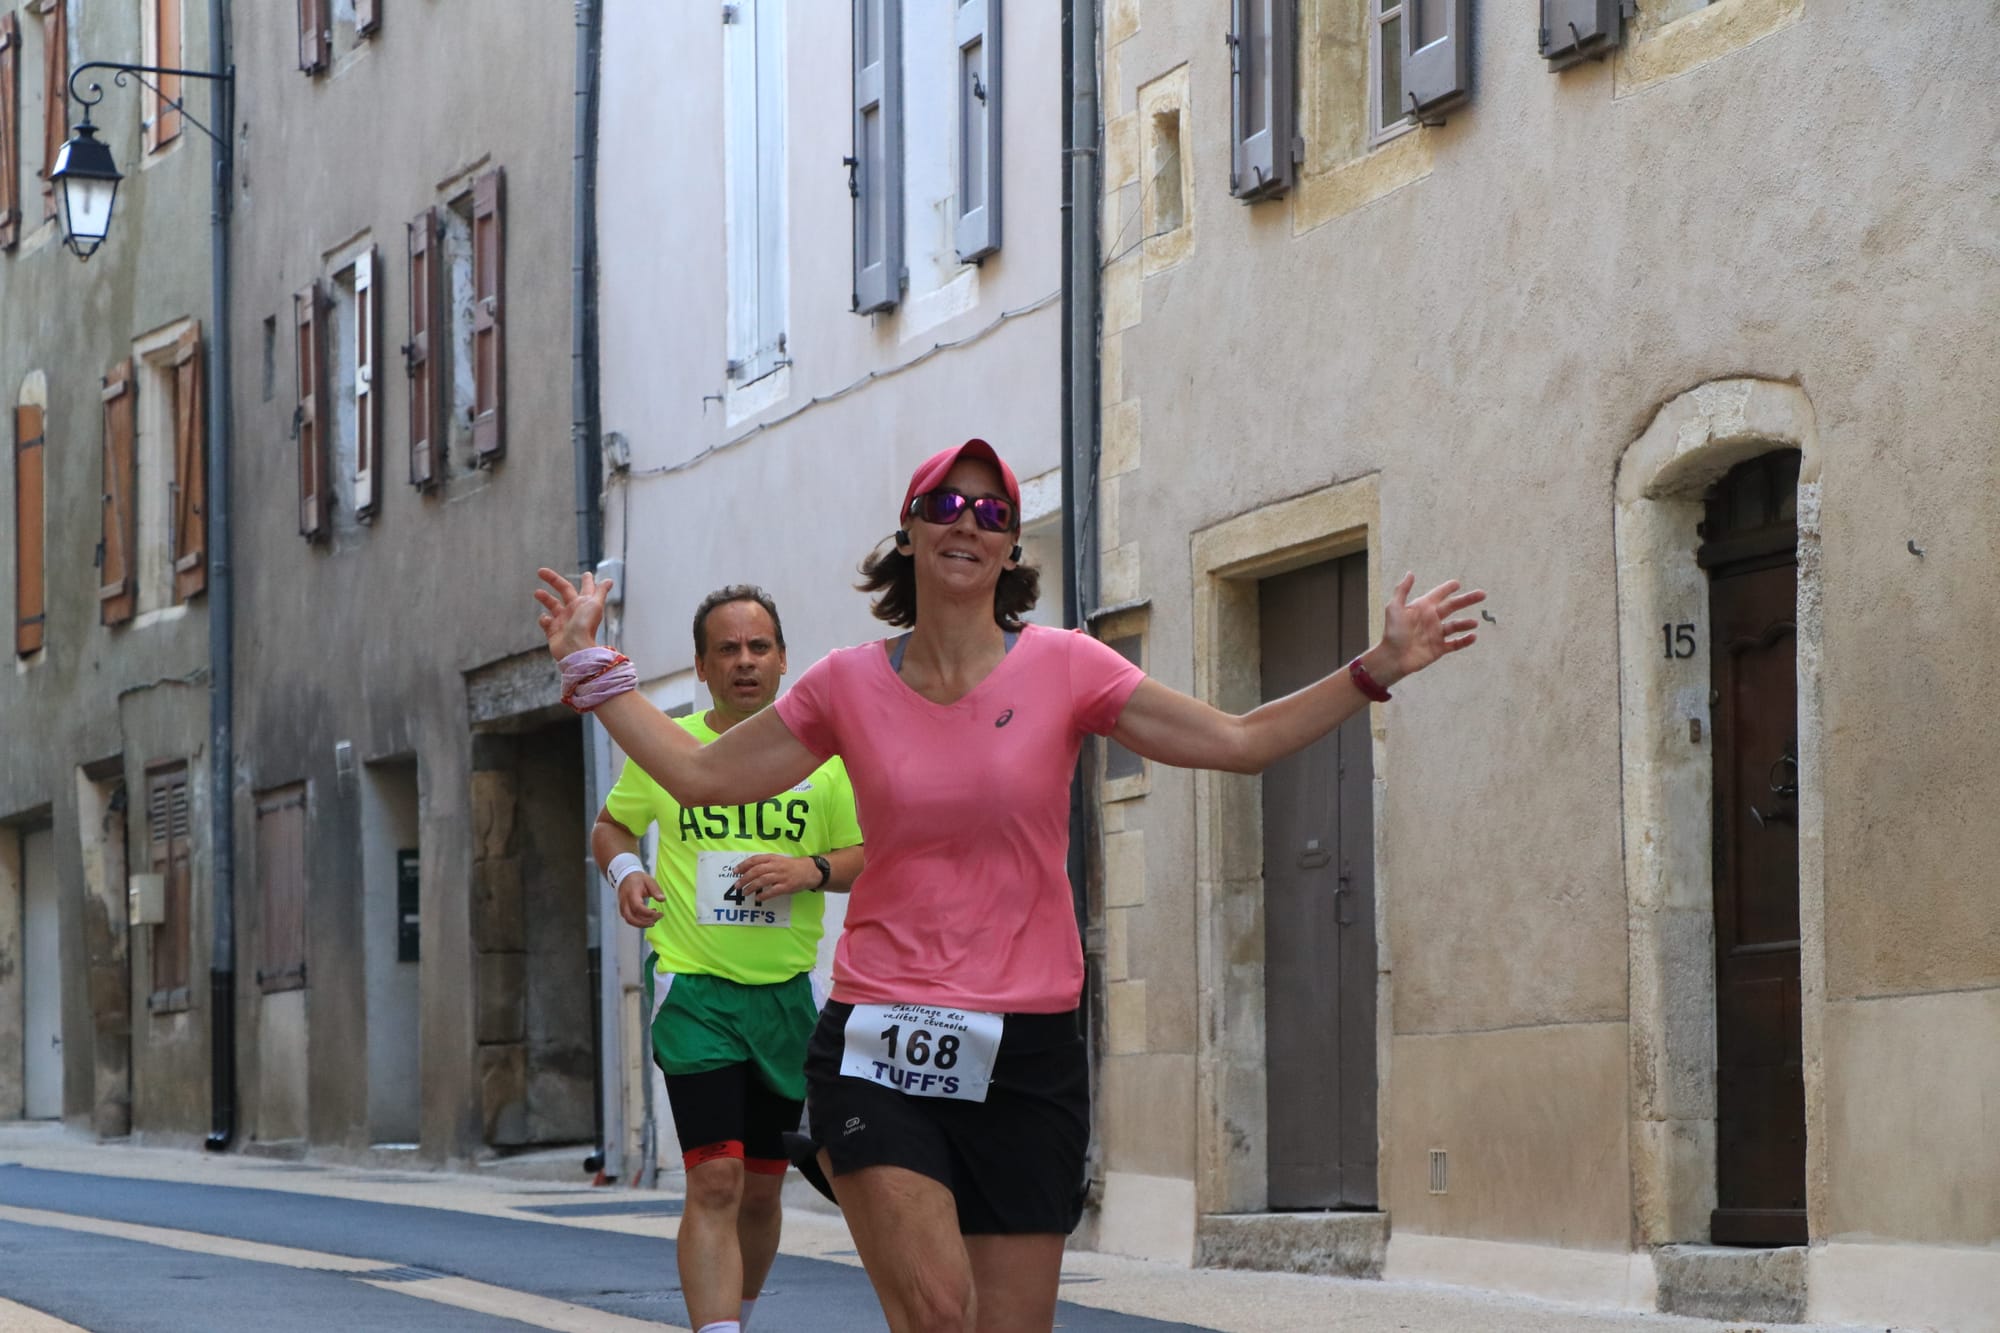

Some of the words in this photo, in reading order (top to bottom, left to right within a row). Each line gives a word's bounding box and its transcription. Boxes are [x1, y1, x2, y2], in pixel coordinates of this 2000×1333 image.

[1662, 623, 1696, 659] 15
[679, 798, 809, 842] ASICS
[713, 908, 776, 924] TUFF'S
[883, 1012, 919, 1022] vallées
[892, 1004, 941, 1018] Challenge
[947, 1012, 965, 1021] des
[880, 1024, 960, 1070] 168
[872, 1061, 960, 1094] TUFF'S
